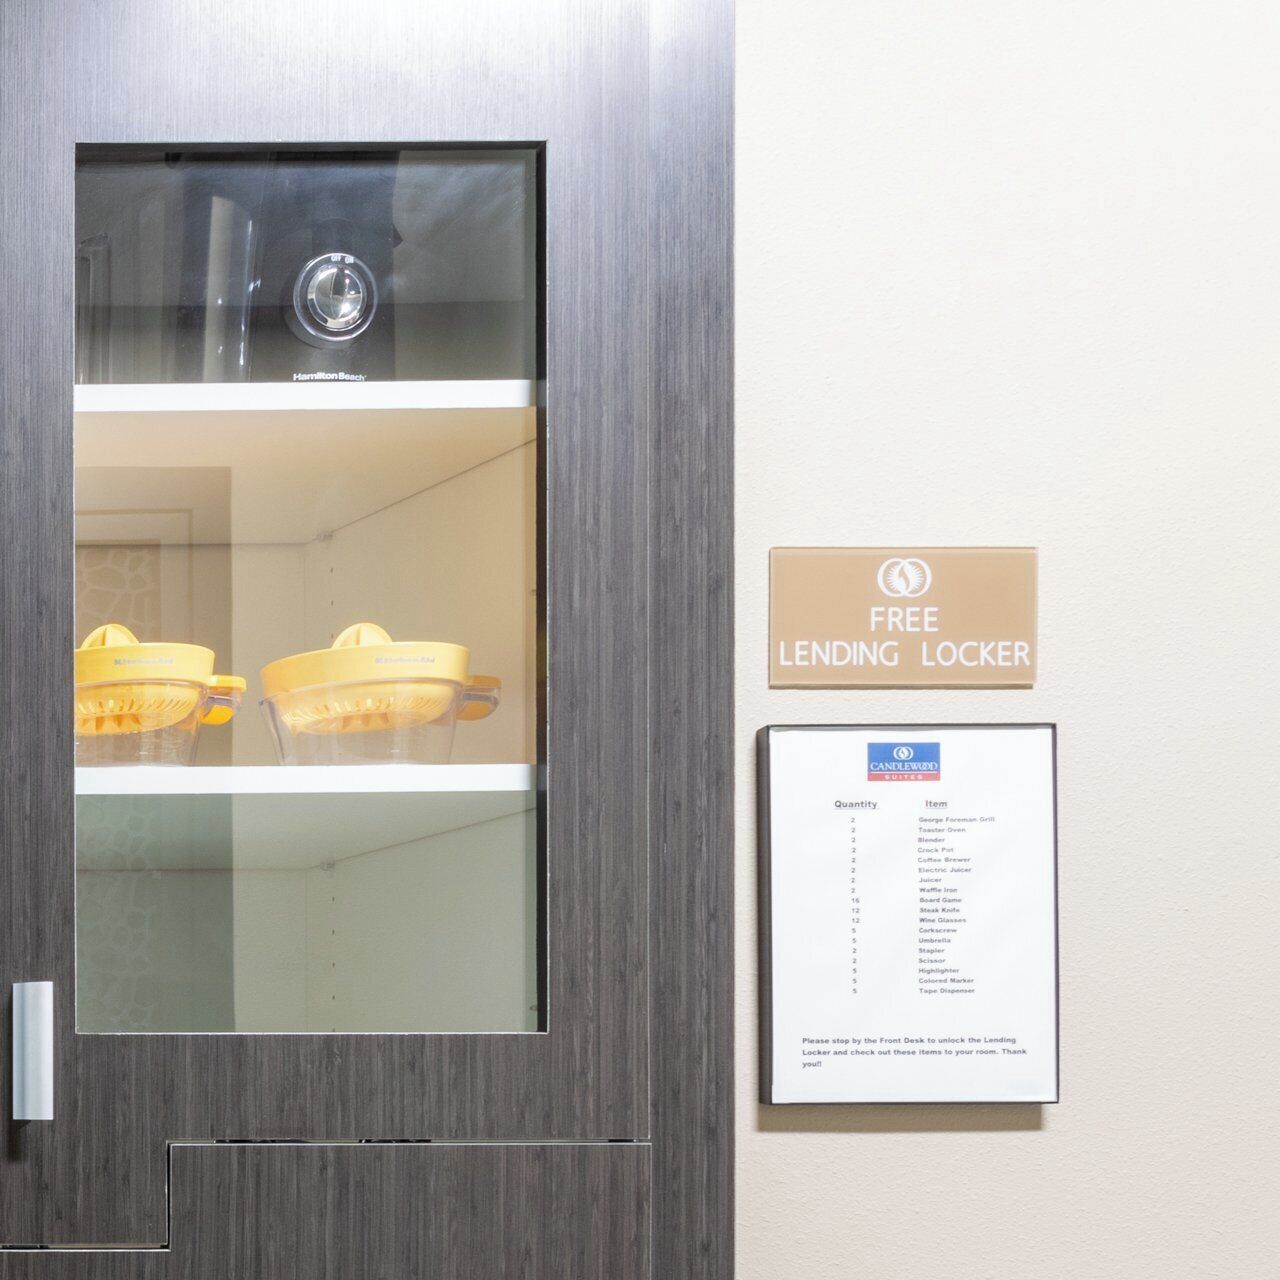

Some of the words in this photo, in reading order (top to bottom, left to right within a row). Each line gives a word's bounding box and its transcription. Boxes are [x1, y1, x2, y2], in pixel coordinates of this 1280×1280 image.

[293, 372, 337, 381] Hamilton
[338, 372, 365, 381] Beach
[870, 608, 939, 632] FREE
[779, 642, 898, 666] LENDING
[922, 641, 1030, 667] LOCKER
[870, 762, 938, 771] CANDLEWOOD
[834, 799, 878, 809] Quantity
[925, 799, 948, 808] Item
[832, 1037, 850, 1046] stop
[852, 1037, 862, 1046] by
[984, 1037, 1017, 1045] Lending
[802, 1048, 830, 1056] Locker
[832, 1048, 848, 1056] and
[850, 1048, 876, 1056] check
[893, 1048, 916, 1056] these
[918, 1048, 942, 1056] items
[802, 1060, 822, 1069] you!!
